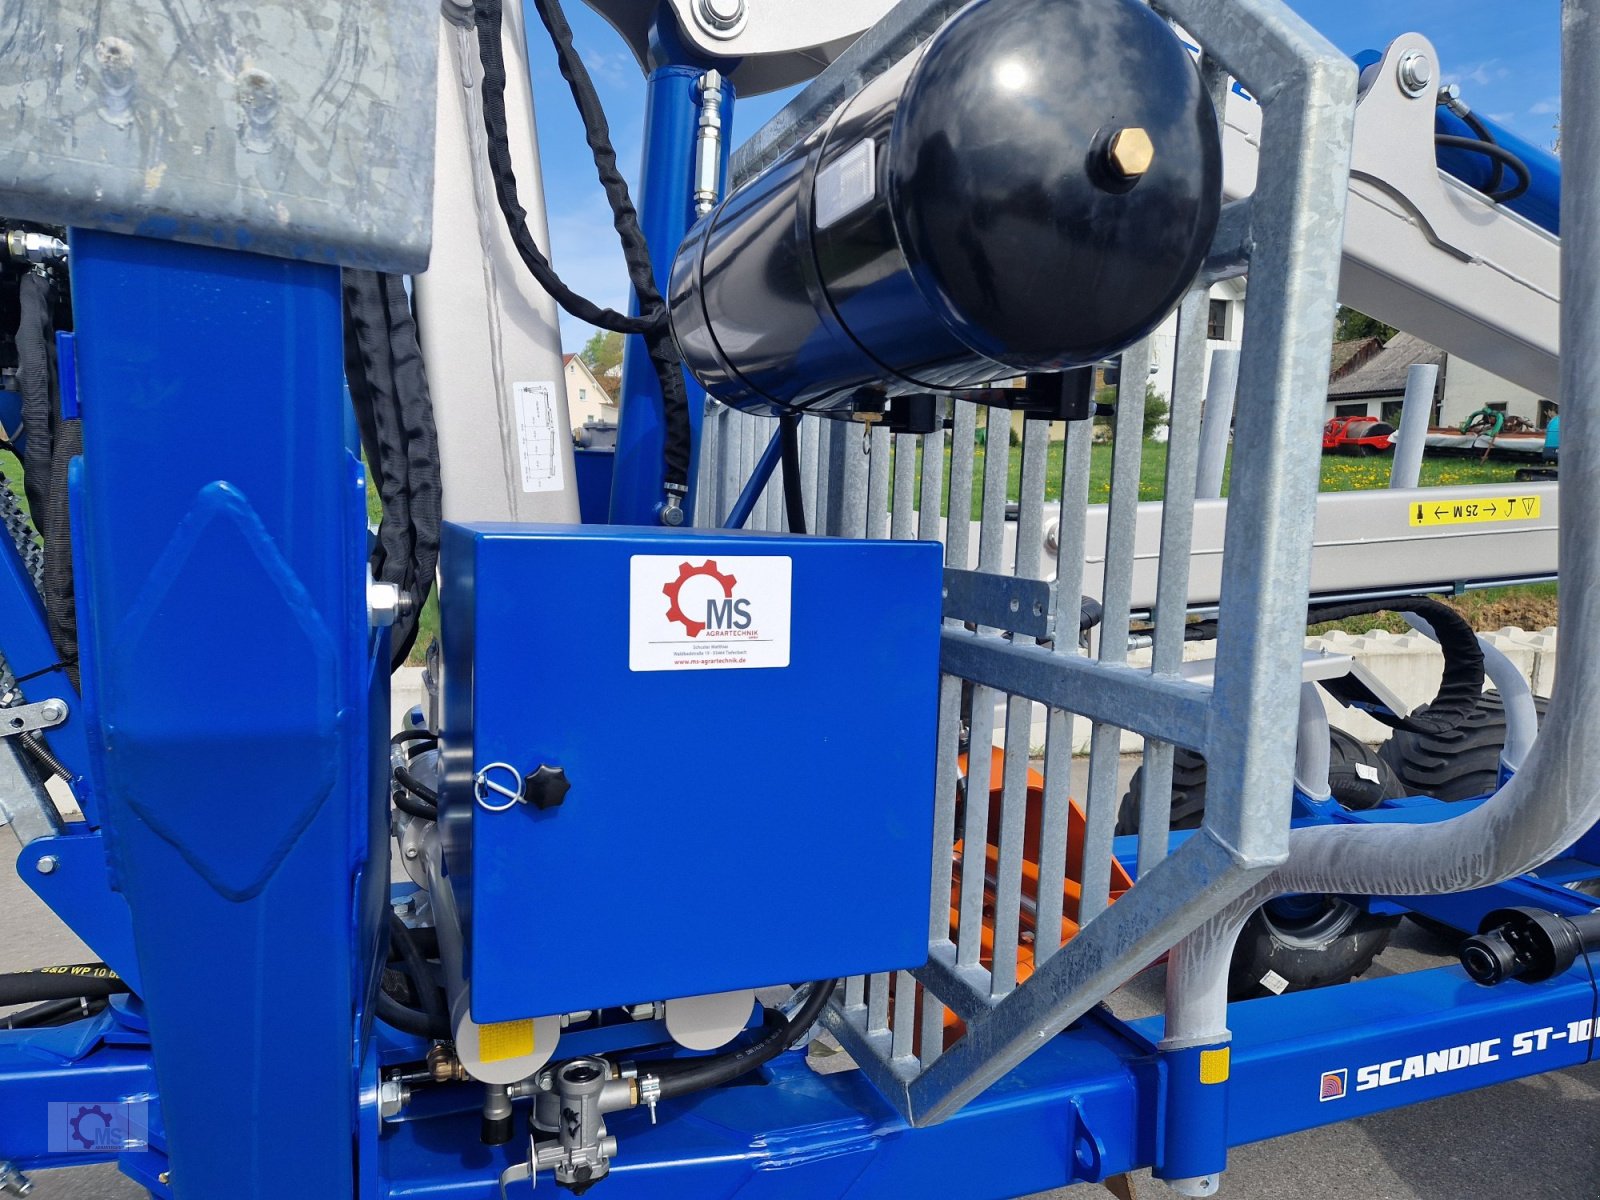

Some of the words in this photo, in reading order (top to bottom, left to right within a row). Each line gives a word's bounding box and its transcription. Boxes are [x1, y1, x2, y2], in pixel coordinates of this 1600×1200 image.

[1453, 505, 1463, 518] M
[1466, 504, 1478, 517] 25
[706, 598, 752, 630] MS
[674, 657, 746, 665] www.ms-agrartechnik.de
[41, 966, 68, 974] S&D
[70, 966, 91, 976] WP
[93, 967, 107, 977] 10
[1356, 1038, 1501, 1091] SCANDIC
[1512, 1016, 1600, 1056] ST-10
